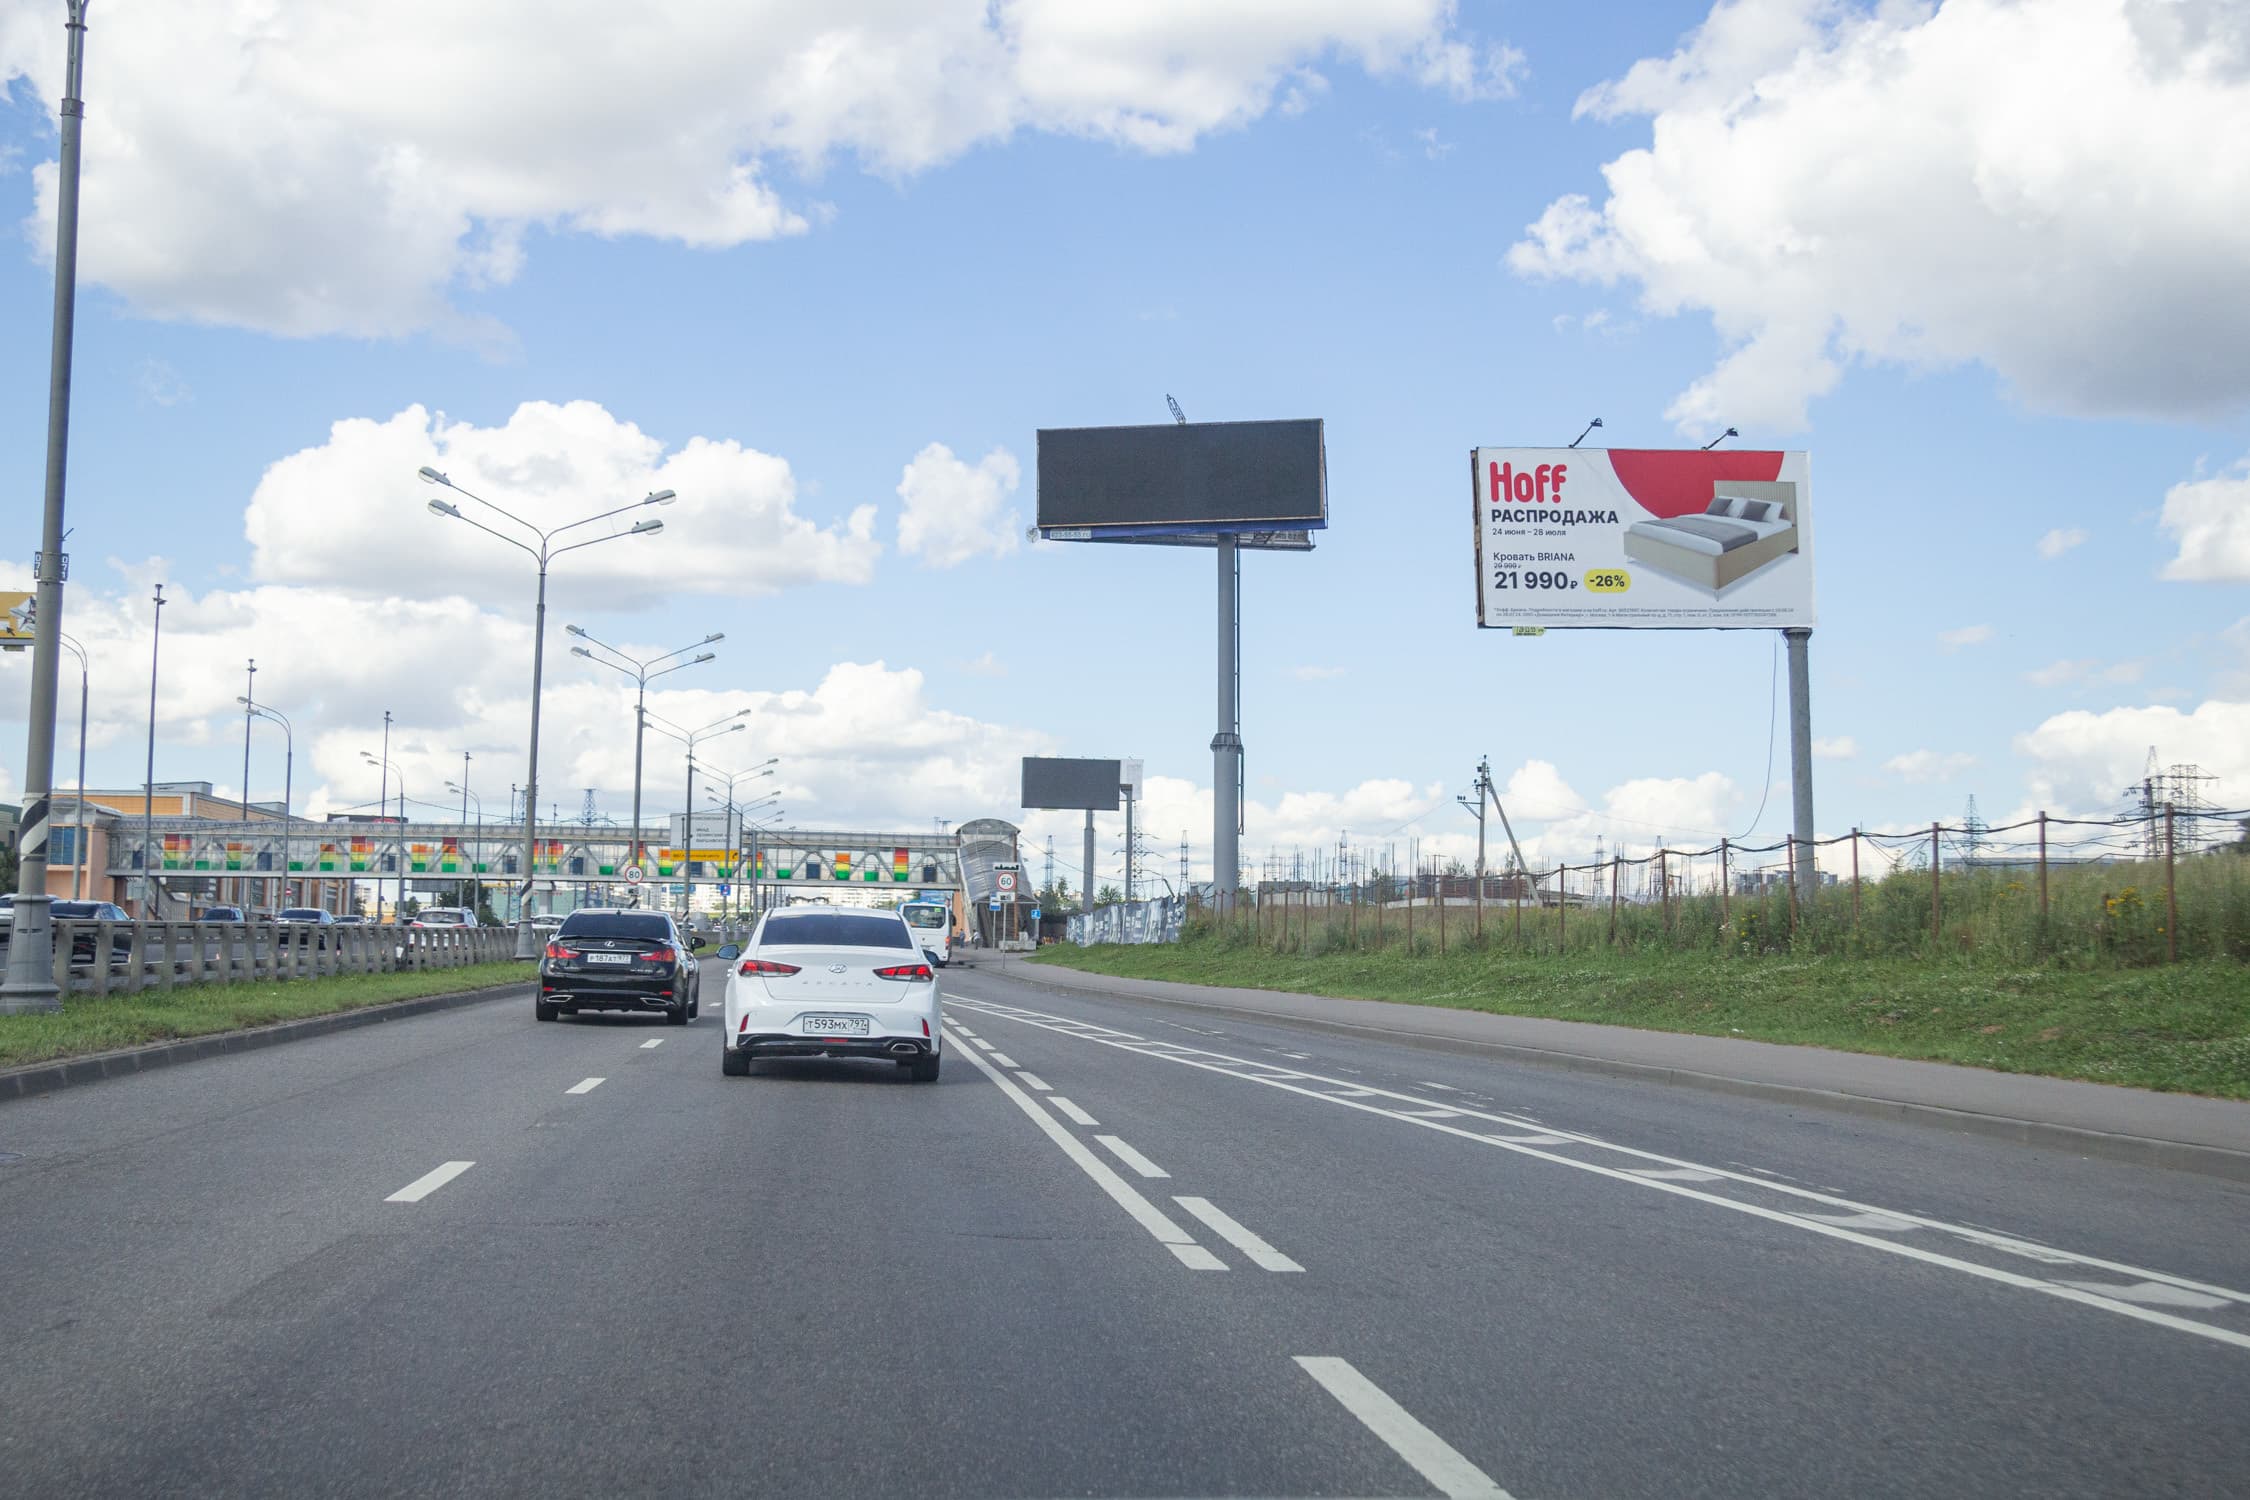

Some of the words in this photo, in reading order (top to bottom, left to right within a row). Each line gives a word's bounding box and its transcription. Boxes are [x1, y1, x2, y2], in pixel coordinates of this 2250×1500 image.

[1491, 509, 1619, 526] РАСПРОДАЖА
[1492, 528, 1503, 536] 24
[1533, 528, 1544, 536] 28
[1493, 552, 1536, 562] Кровать
[1537, 552, 1576, 562] BRIANA
[1589, 574, 1626, 588] -26%
[628, 870, 640, 879] 80
[1001, 877, 1012, 886] 60
